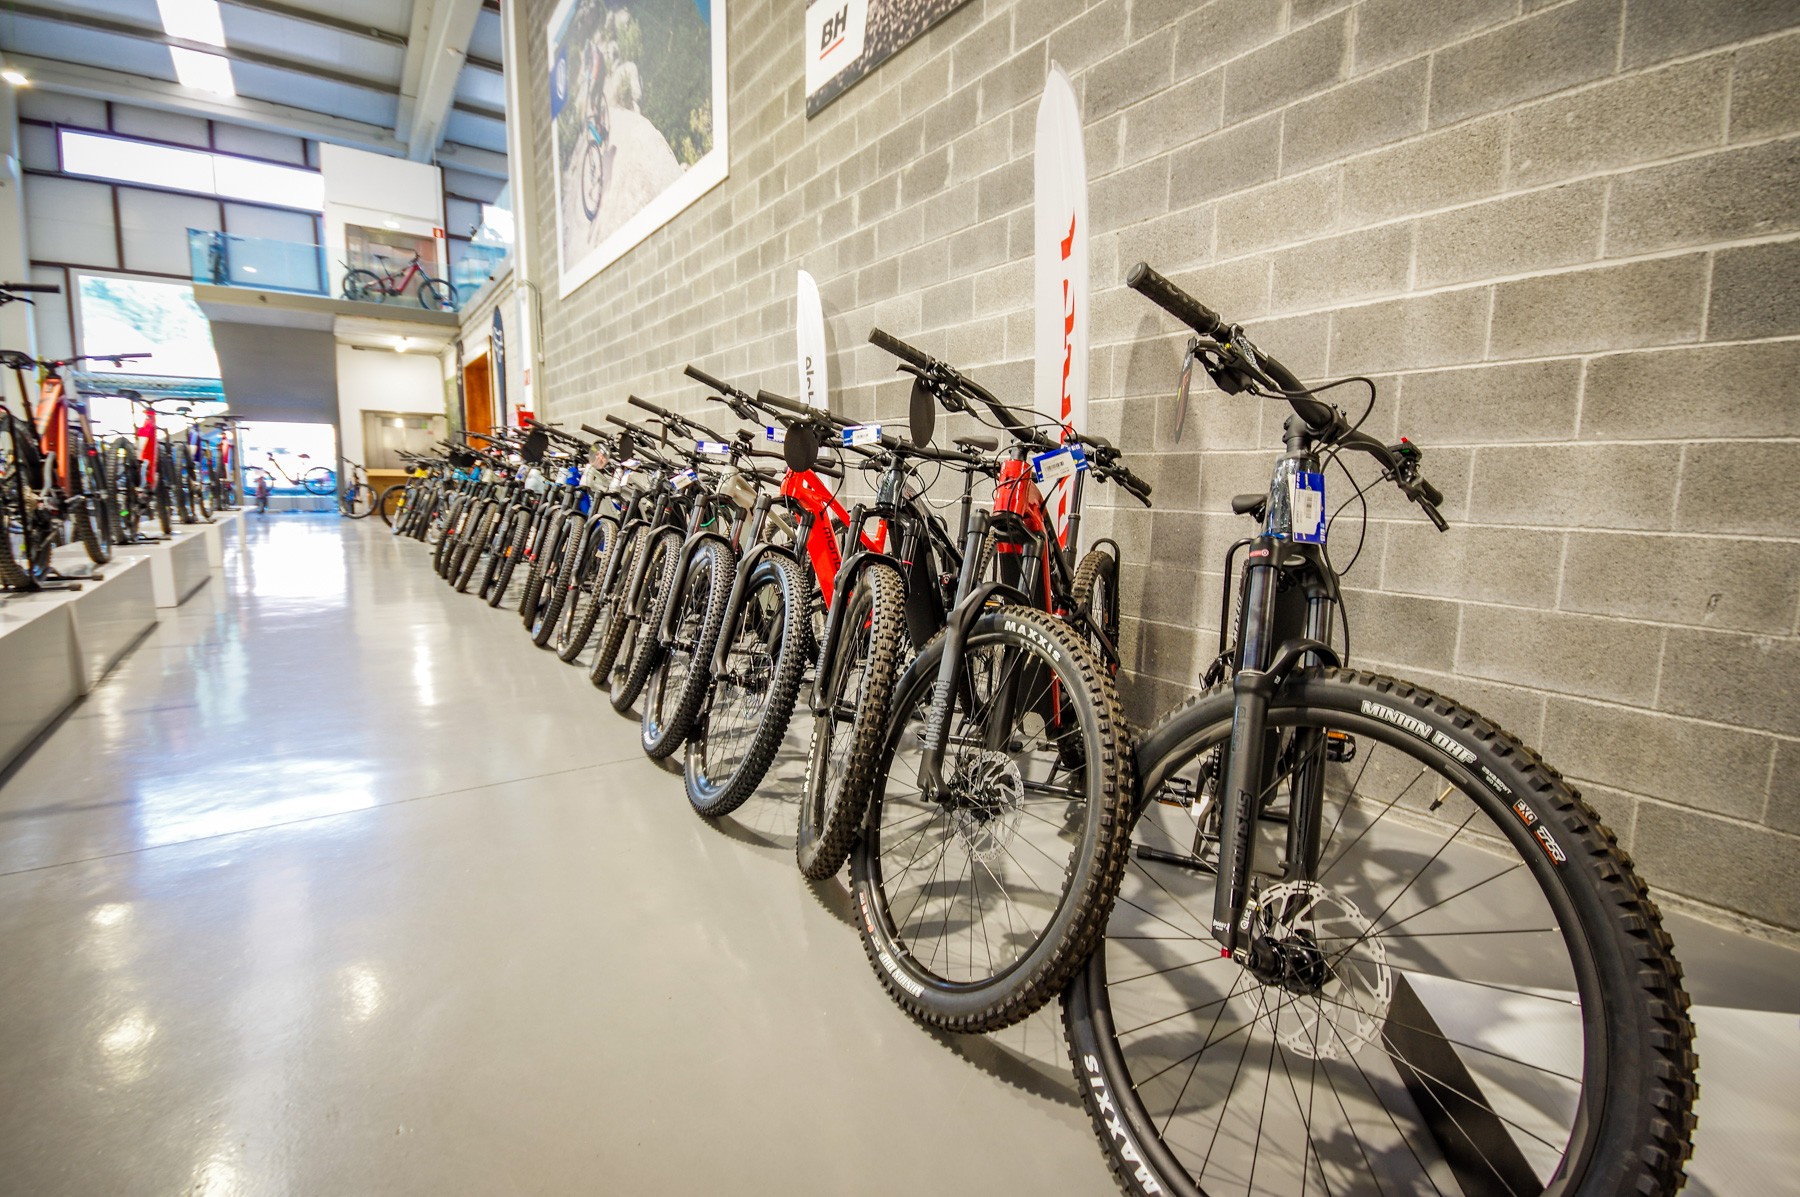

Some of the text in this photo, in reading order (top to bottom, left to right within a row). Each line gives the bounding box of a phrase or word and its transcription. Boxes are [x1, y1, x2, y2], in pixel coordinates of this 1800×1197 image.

[821, 3, 848, 51] BH
[1004, 620, 1061, 662] MAXXIS
[923, 680, 950, 750] ROCKSHOX
[1361, 699, 1478, 764] MINION DHF
[1516, 799, 1537, 823] EXO
[1084, 1054, 1164, 1197] MAXXIS
